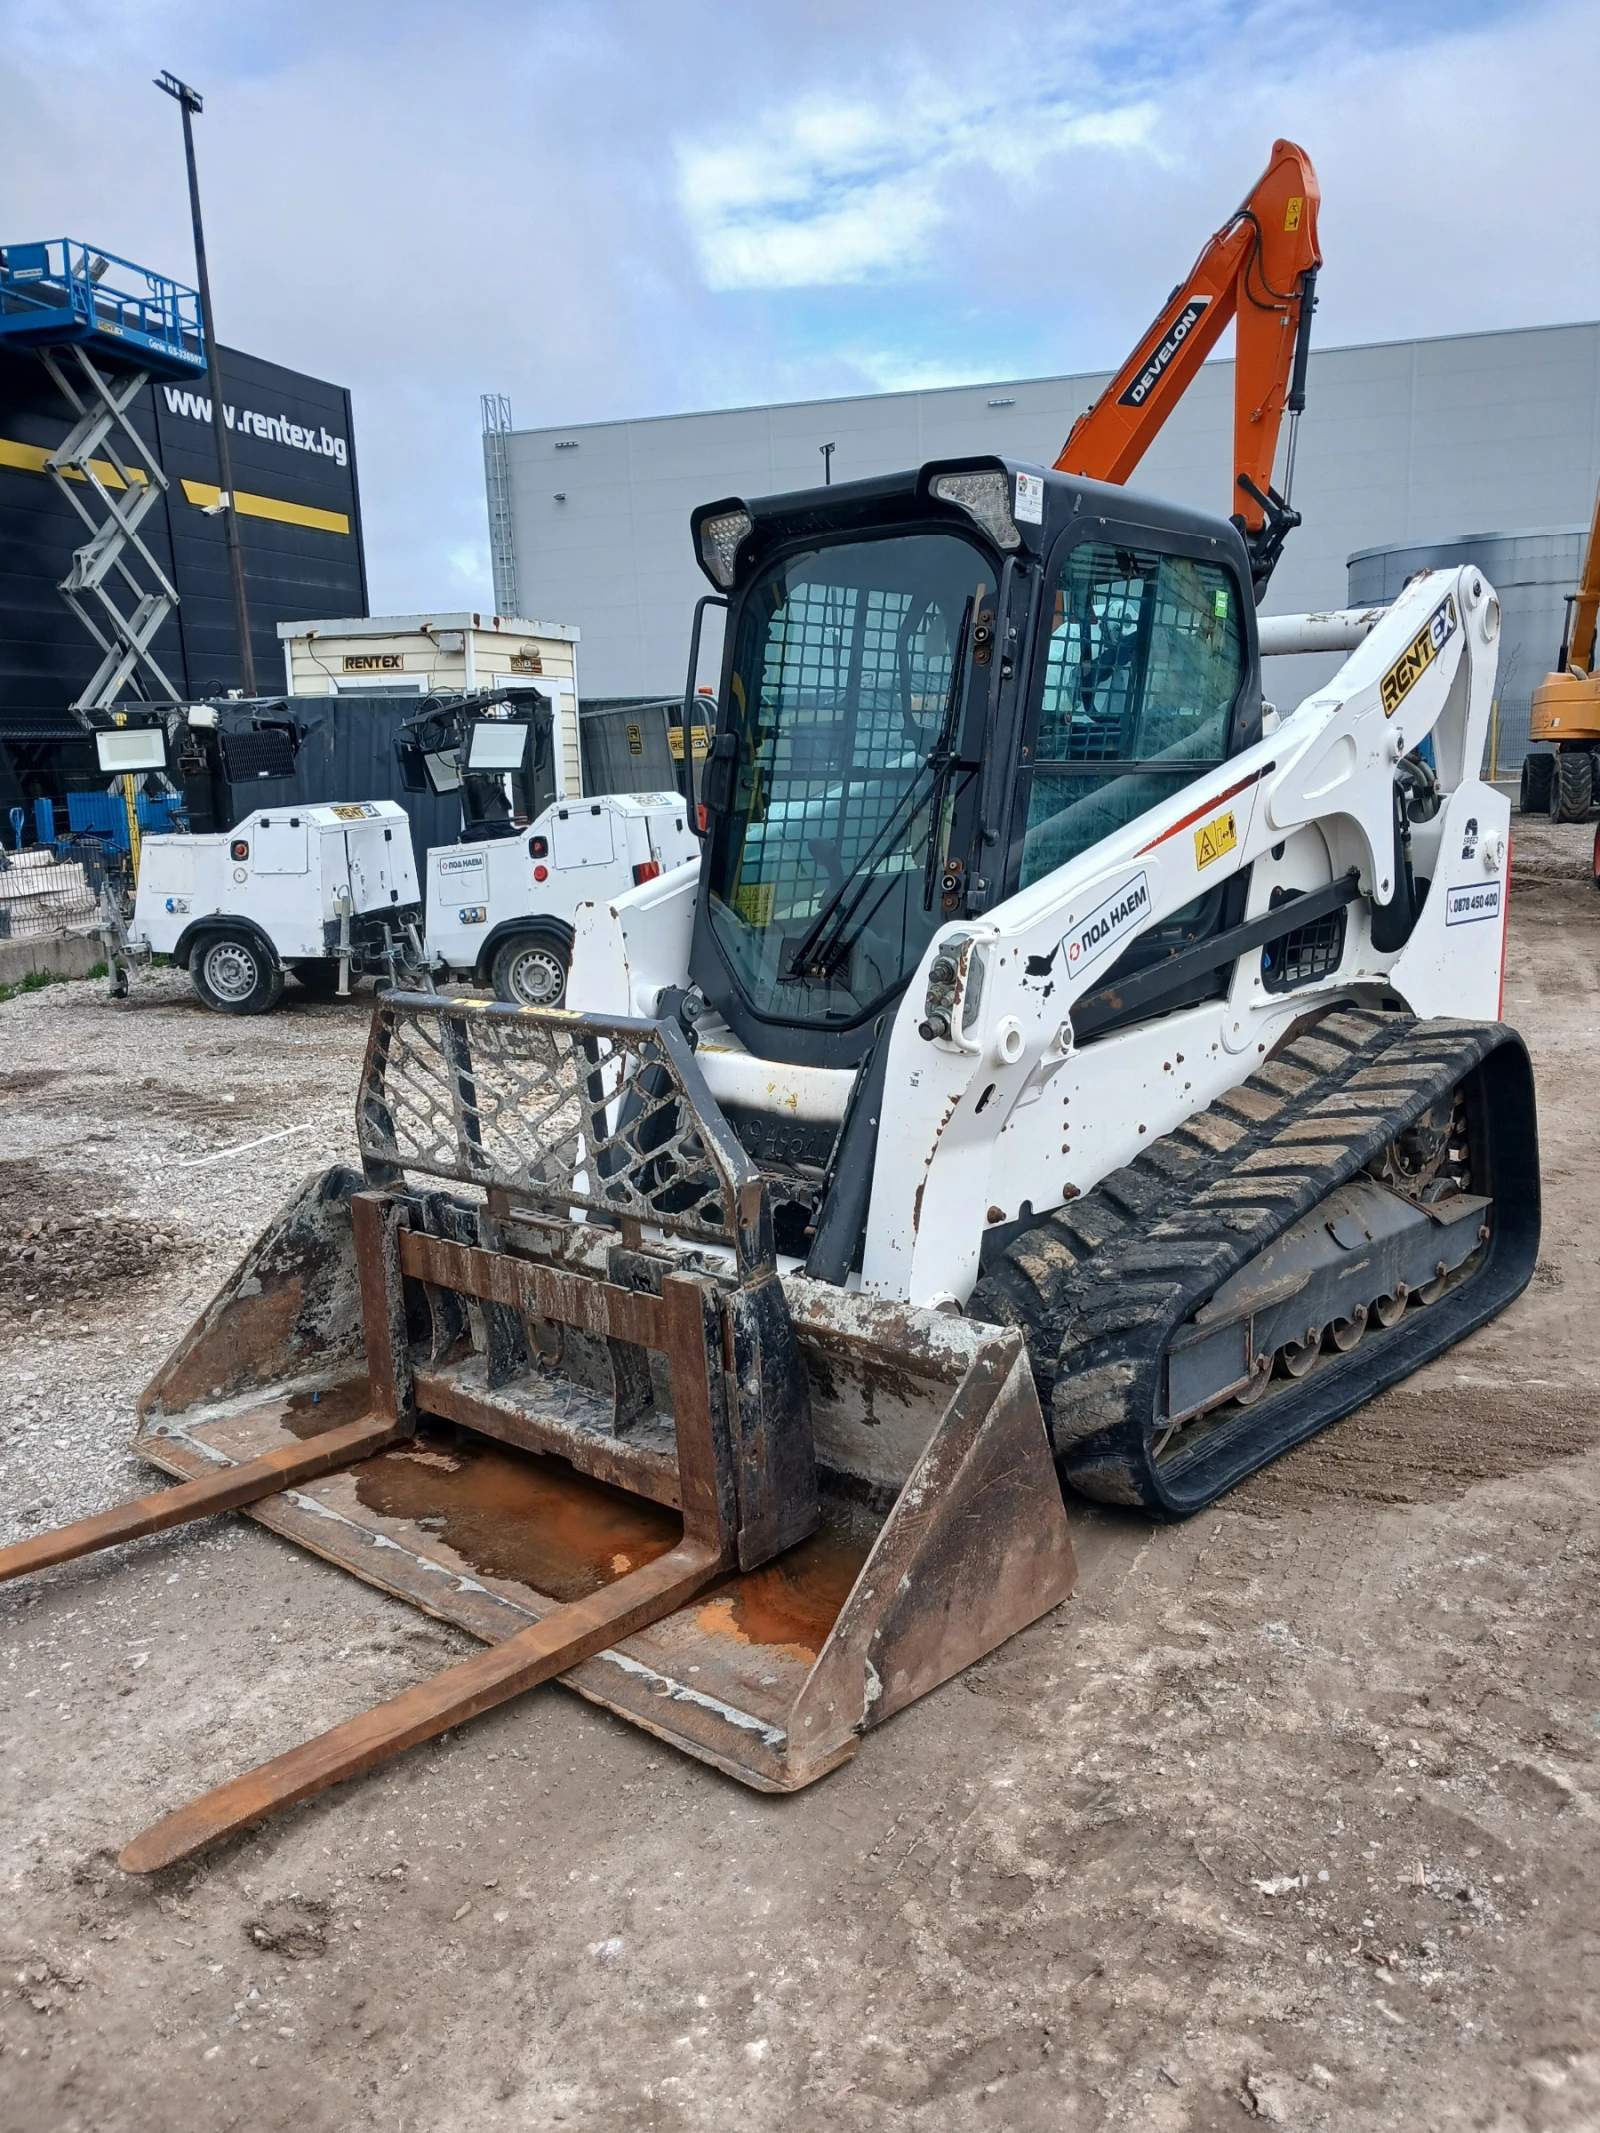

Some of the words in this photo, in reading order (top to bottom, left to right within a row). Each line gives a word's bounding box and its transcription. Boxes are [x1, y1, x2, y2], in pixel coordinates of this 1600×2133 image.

[148, 339, 166, 352] Genie
[1131, 309, 1198, 403] DEVELON
[345, 655, 400, 669] RENTEX
[1383, 600, 1455, 711] RENTEX
[1463, 836, 1479, 845] SPEED
[448, 860, 462, 869] ПОД
[462, 858, 482, 866] НАЕМ
[1453, 896, 1470, 913] 0878
[1470, 894, 1484, 910] 450
[1484, 892, 1498, 907] 400
[1081, 917, 1110, 952] ПОД
[1109, 885, 1147, 928] НАЕМ
